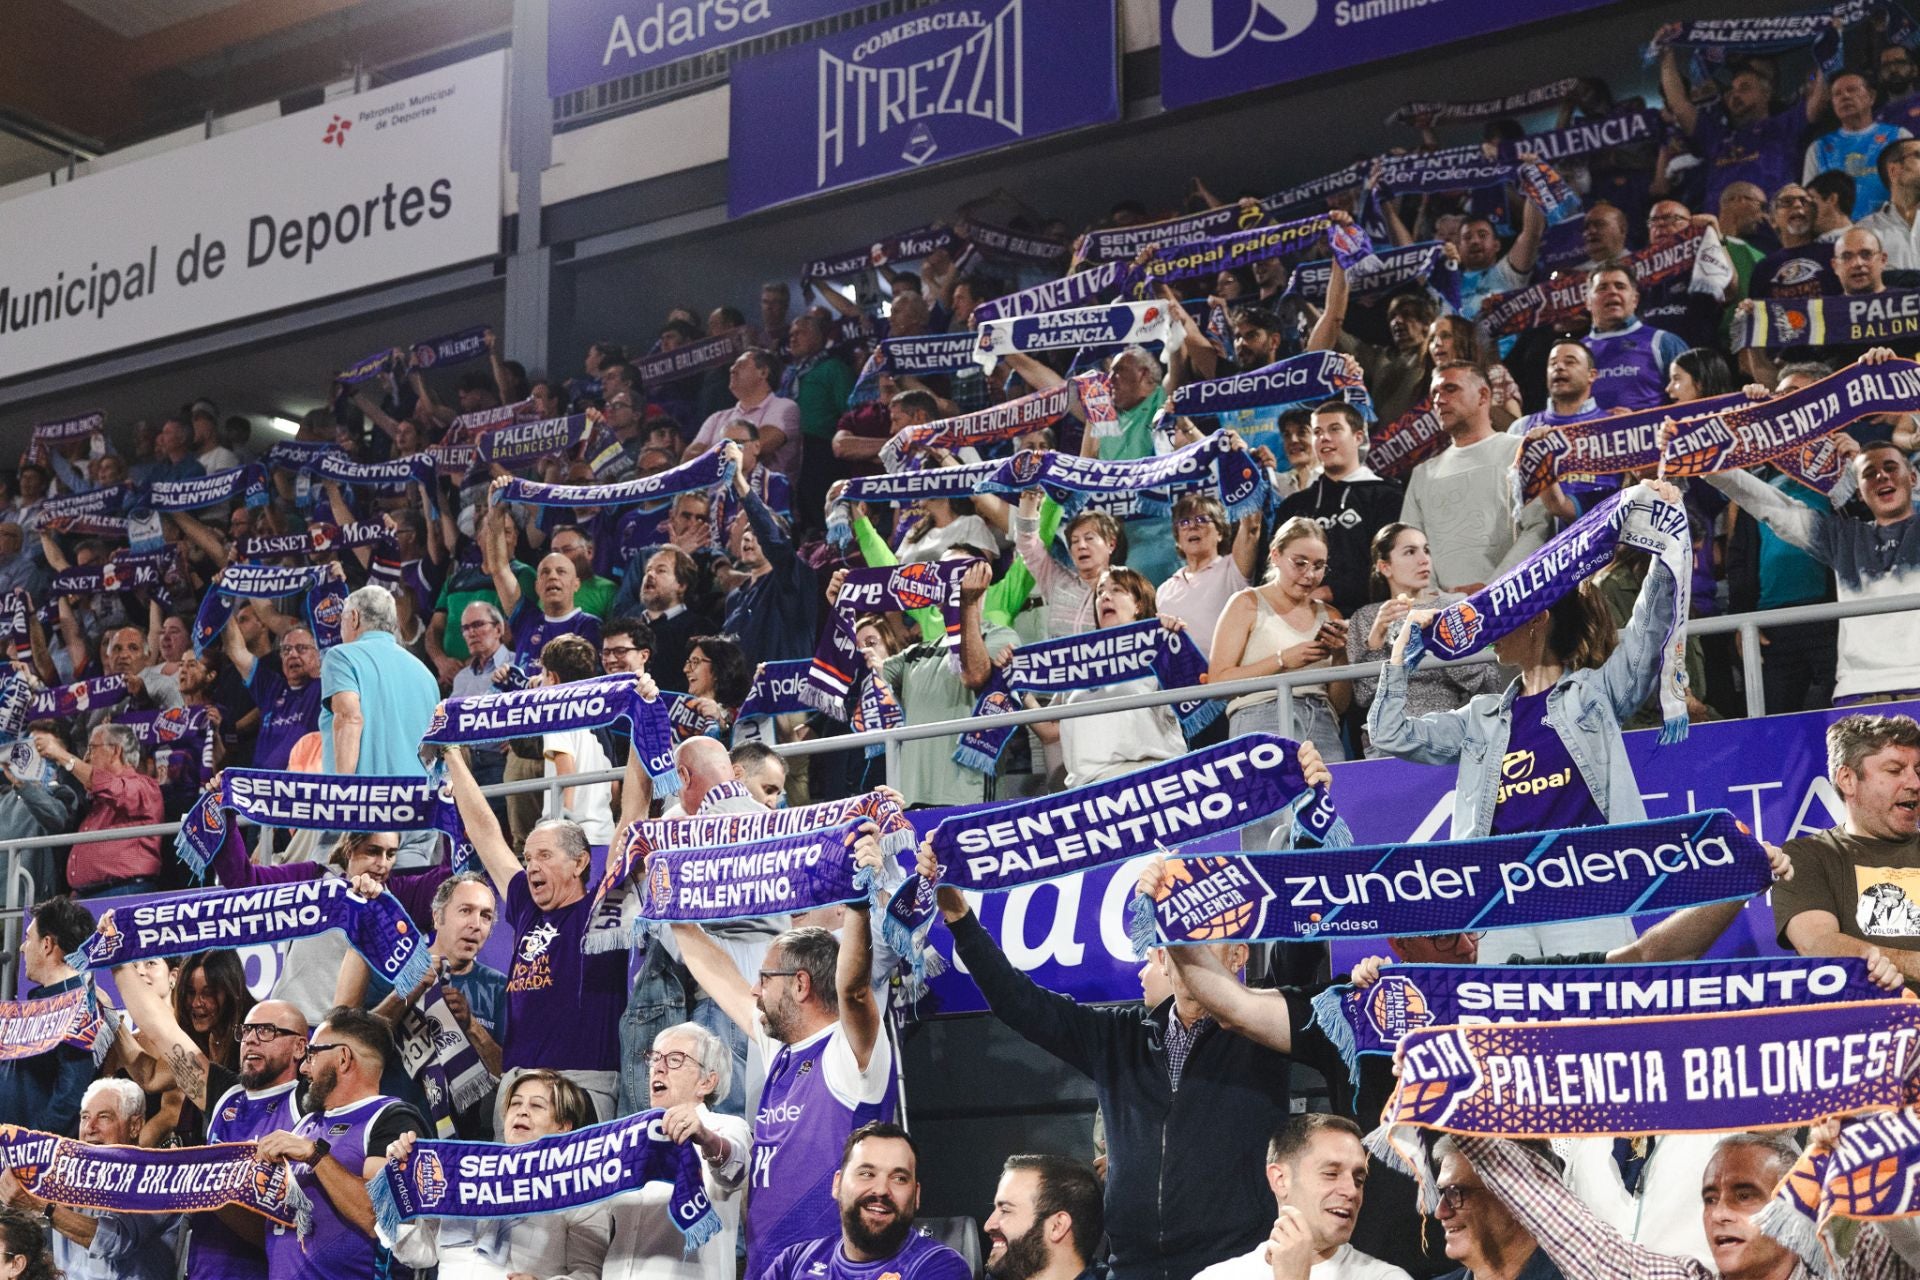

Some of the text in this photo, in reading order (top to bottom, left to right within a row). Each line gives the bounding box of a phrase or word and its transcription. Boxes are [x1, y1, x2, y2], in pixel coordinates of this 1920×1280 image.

[852, 11, 986, 61] COMERCIAL
[359, 84, 456, 121] Patronato Municipal
[817, 0, 1023, 187] ATREZZO
[375, 106, 438, 131] de Deportes
[1514, 115, 1650, 160] PALENCIA
[1421, 163, 1513, 184] palencia
[176, 233, 227, 287] de
[247, 177, 452, 268] Deportes
[1100, 210, 1232, 247] SENTIMIENTO
[1231, 219, 1332, 257] palencia
[996, 261, 1118, 320] PALENCIA
[1026, 326, 1116, 347] PALENCIA
[1038, 309, 1110, 329] BASKET
[439, 336, 481, 356] PALENCIA
[675, 338, 733, 369] BALONCESTO
[1200, 367, 1309, 402] palencia
[494, 416, 569, 447] PALENCIA
[953, 410, 1020, 437] PALENCIA
[1733, 394, 1840, 454] PALENCIA
[492, 434, 569, 459] BALONCESTO
[1368, 431, 1415, 472] ENCIA
[321, 458, 413, 477] PALENTINO.
[1047, 457, 1206, 487] PALENTINO.
[43, 485, 118, 511] SENTIMIENTO
[549, 477, 665, 501] PALENTINO.
[1225, 480, 1254, 504] acb
[1650, 499, 1688, 541] REAL
[891, 575, 946, 603] PALENCIA
[1489, 530, 1591, 617] PALENCIA
[1450, 605, 1468, 648] ZUNDER
[458, 697, 612, 732] PALENTINO.
[956, 743, 1285, 854] SENTIMIENTO
[1496, 767, 1571, 804] gropal
[232, 793, 424, 823] PALENTINO.
[643, 816, 732, 850] PALENCIA
[966, 792, 1249, 881] PALENTINO.
[454, 842, 474, 869] acb
[680, 843, 823, 884] SENTIMIENTO
[1285, 831, 1736, 908] zunder palencia
[680, 876, 796, 909] PALENTINO.
[1157, 864, 1250, 928] ZUNDER
[1181, 889, 1246, 931] PALENCIA
[138, 904, 329, 949] PALENTINO.
[384, 933, 414, 973] acb
[1456, 965, 1847, 1012] SENTIMIENTO
[1384, 988, 1394, 1030] PALENCIA
[1390, 981, 1406, 1037] ZUNDER
[1487, 1049, 1668, 1106] PALENCIA
[459, 1115, 671, 1179] SENTIMIENTO
[57, 1160, 135, 1194] PALENCIA
[137, 1158, 250, 1194] BALONCESTO
[425, 1154, 434, 1201] ZUNDER
[459, 1158, 632, 1205] PALENTINO.
[752, 1146, 777, 1188] 14
